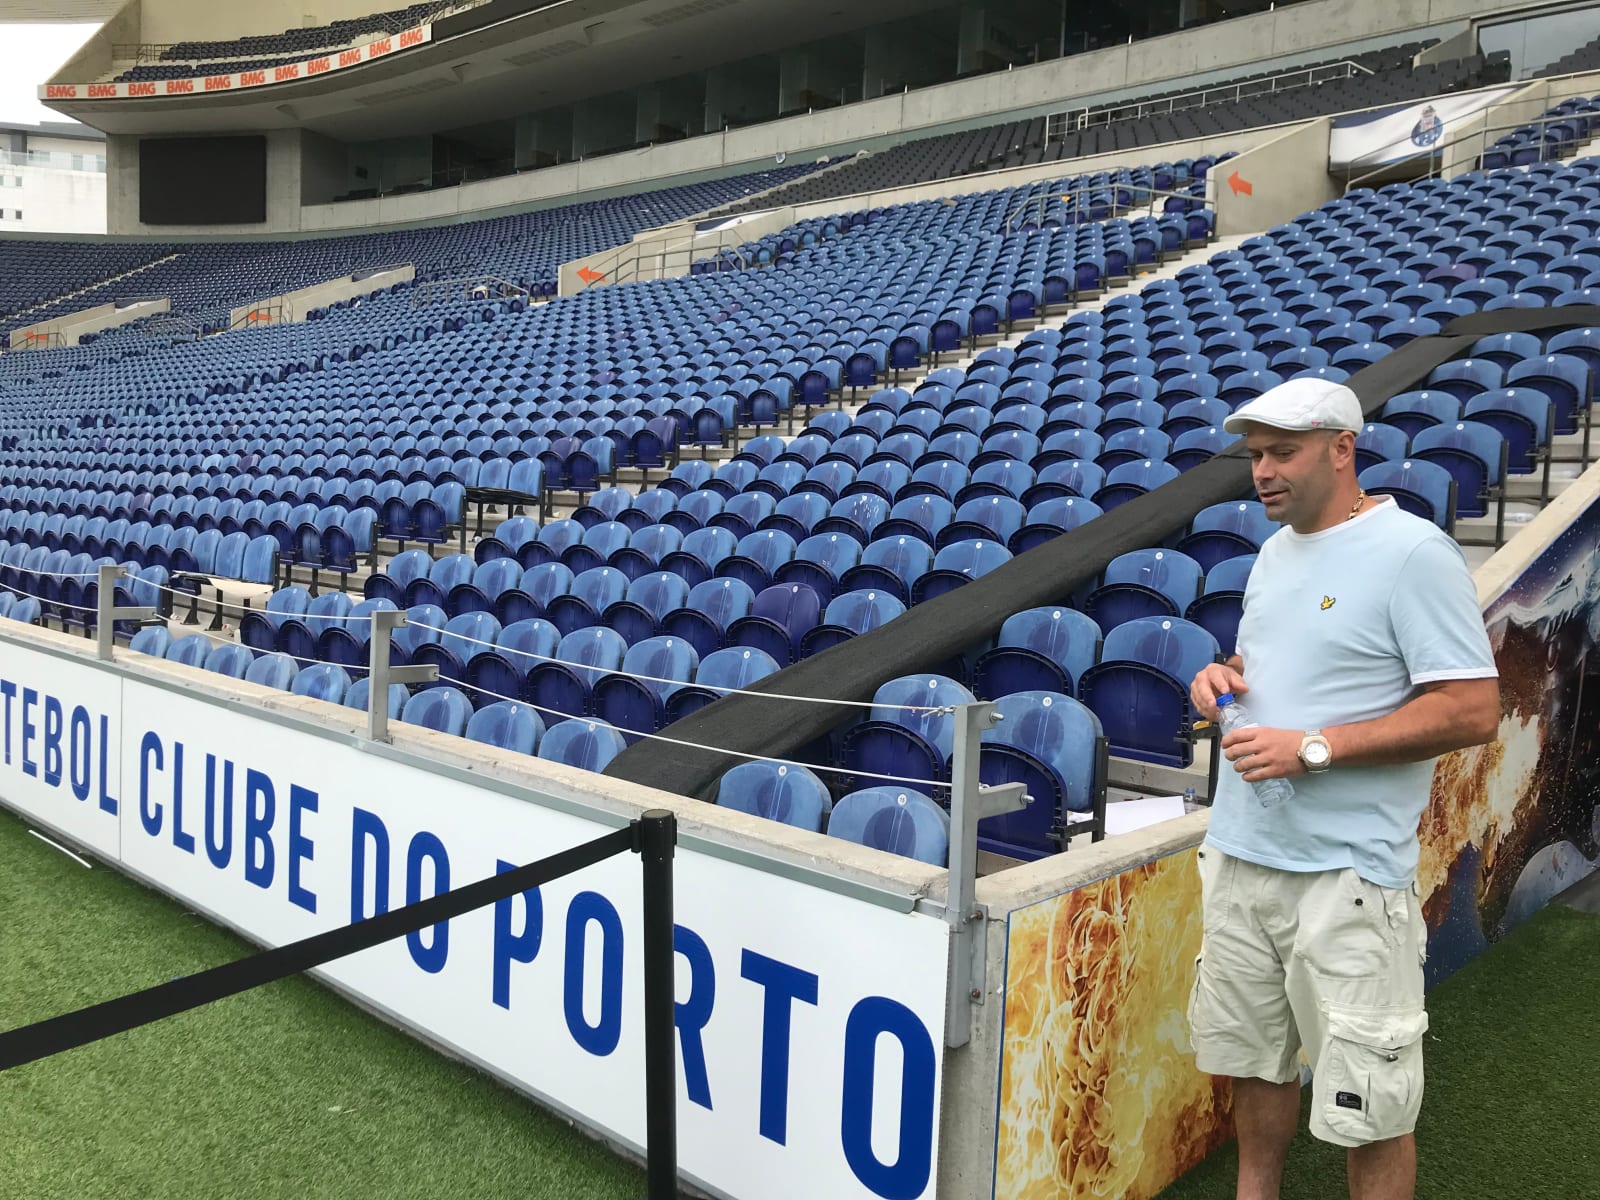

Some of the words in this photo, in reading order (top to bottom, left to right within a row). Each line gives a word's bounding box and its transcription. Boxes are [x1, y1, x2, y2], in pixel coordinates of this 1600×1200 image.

[47, 85, 76, 98] BMG
[88, 85, 116, 97] BMG
[128, 83, 156, 96] BMG
[166, 80, 194, 94] BMG
[205, 76, 231, 90] BMG
[240, 71, 265, 86] BMG
[275, 65, 298, 81] BMG
[307, 58, 330, 75] BMG
[339, 48, 361, 67] BMG
[369, 39, 391, 58] BMG
[400, 28, 423, 48] BMG
[139, 730, 319, 914] CLUBE
[350, 806, 451, 974] DO
[492, 859, 936, 1200] PORTO
